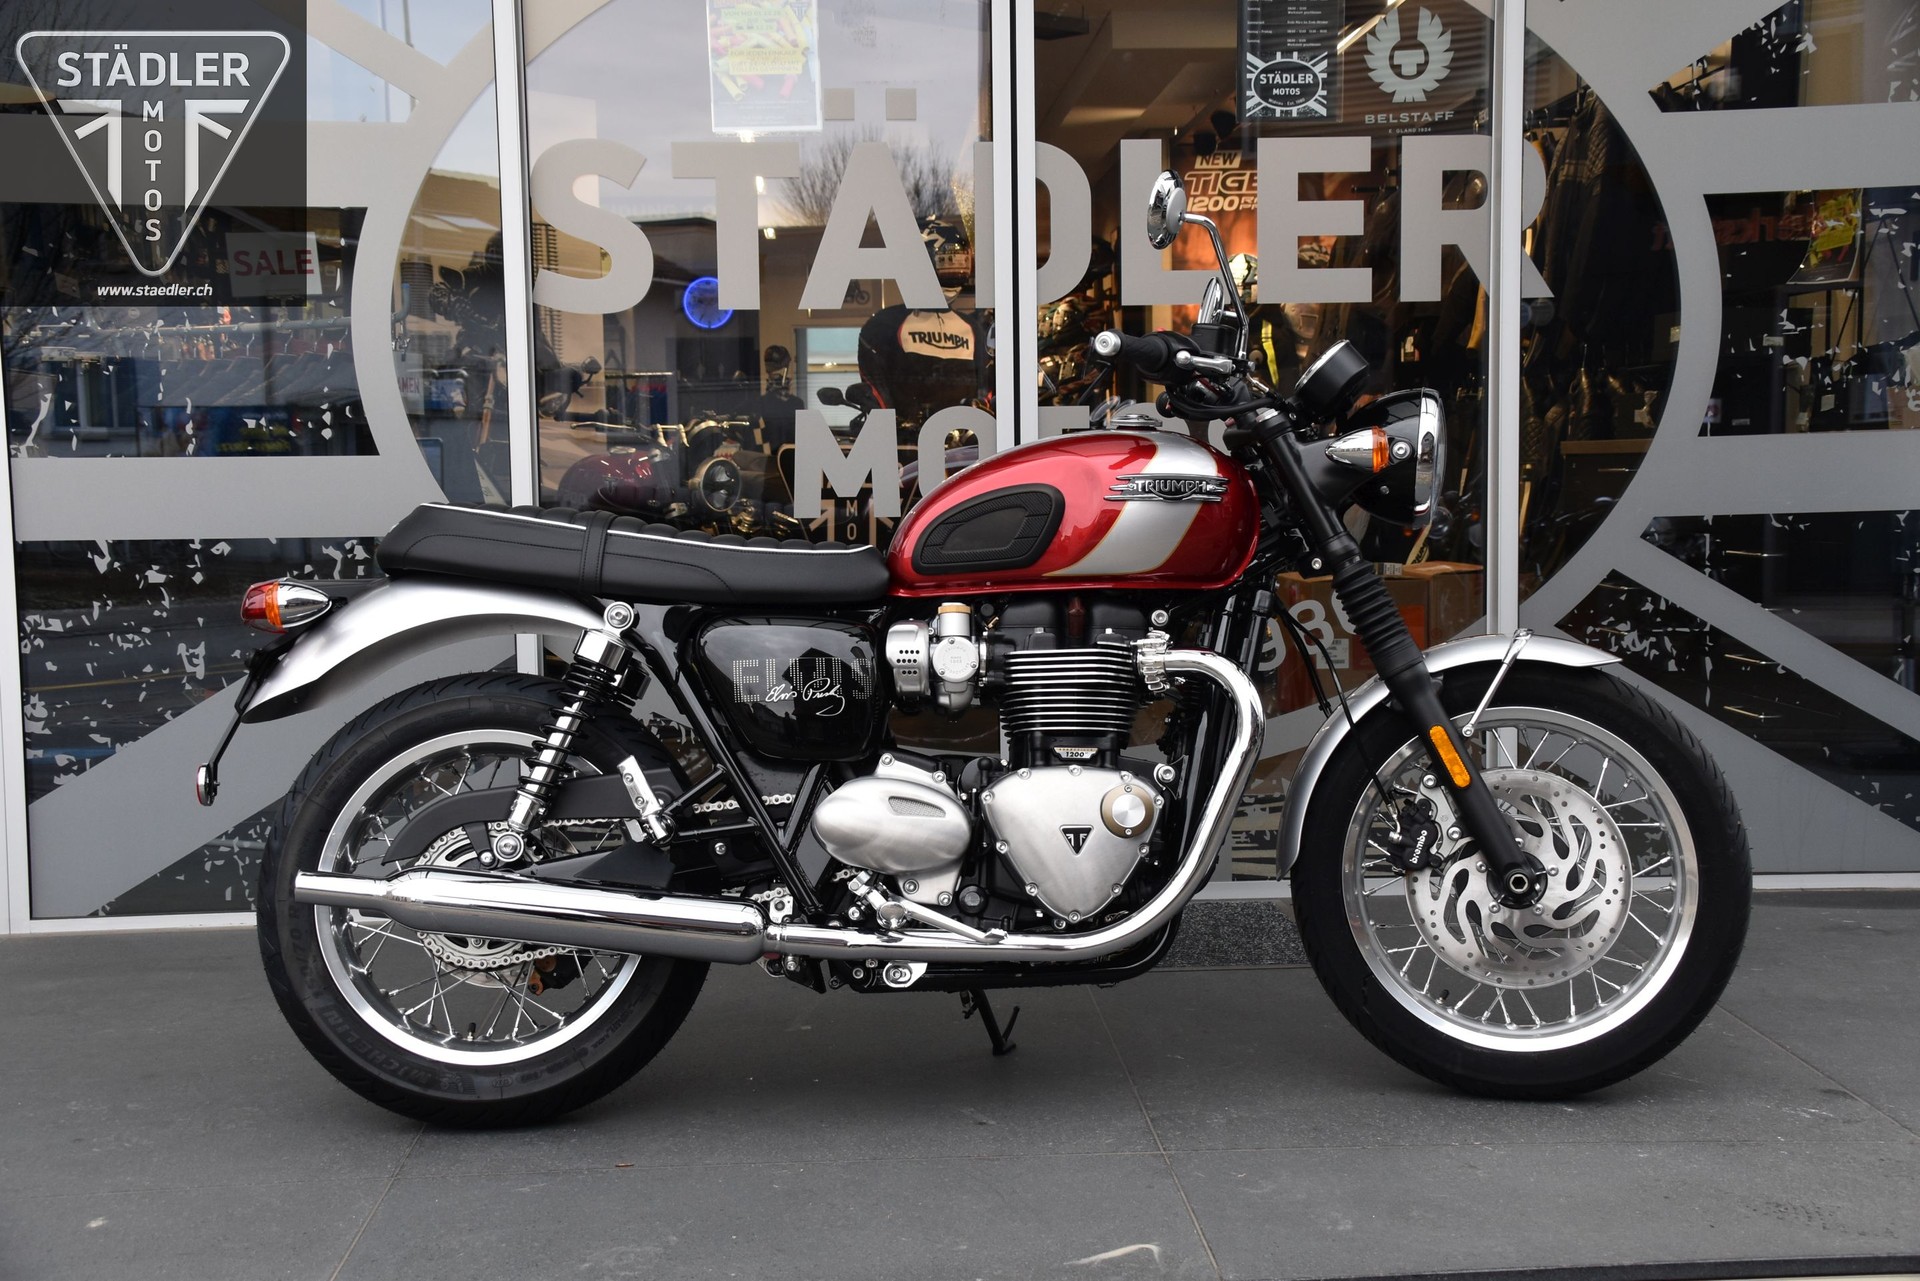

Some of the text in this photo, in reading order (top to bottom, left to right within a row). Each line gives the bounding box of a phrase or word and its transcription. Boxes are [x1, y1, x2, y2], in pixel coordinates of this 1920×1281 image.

[1260, 71, 1314, 84] STÄDLER
[1365, 111, 1455, 124] BELSTAFF
[1199, 152, 1238, 167] NEW
[530, 88, 1554, 315] STÄDLER
[1187, 196, 1240, 212] 1200
[233, 250, 314, 277] SALE
[908, 331, 969, 350] TRIUMPH
[1135, 480, 1206, 498] TRIUMPH
[1066, 751, 1085, 759] 1200
[1409, 830, 1428, 864] brembo
